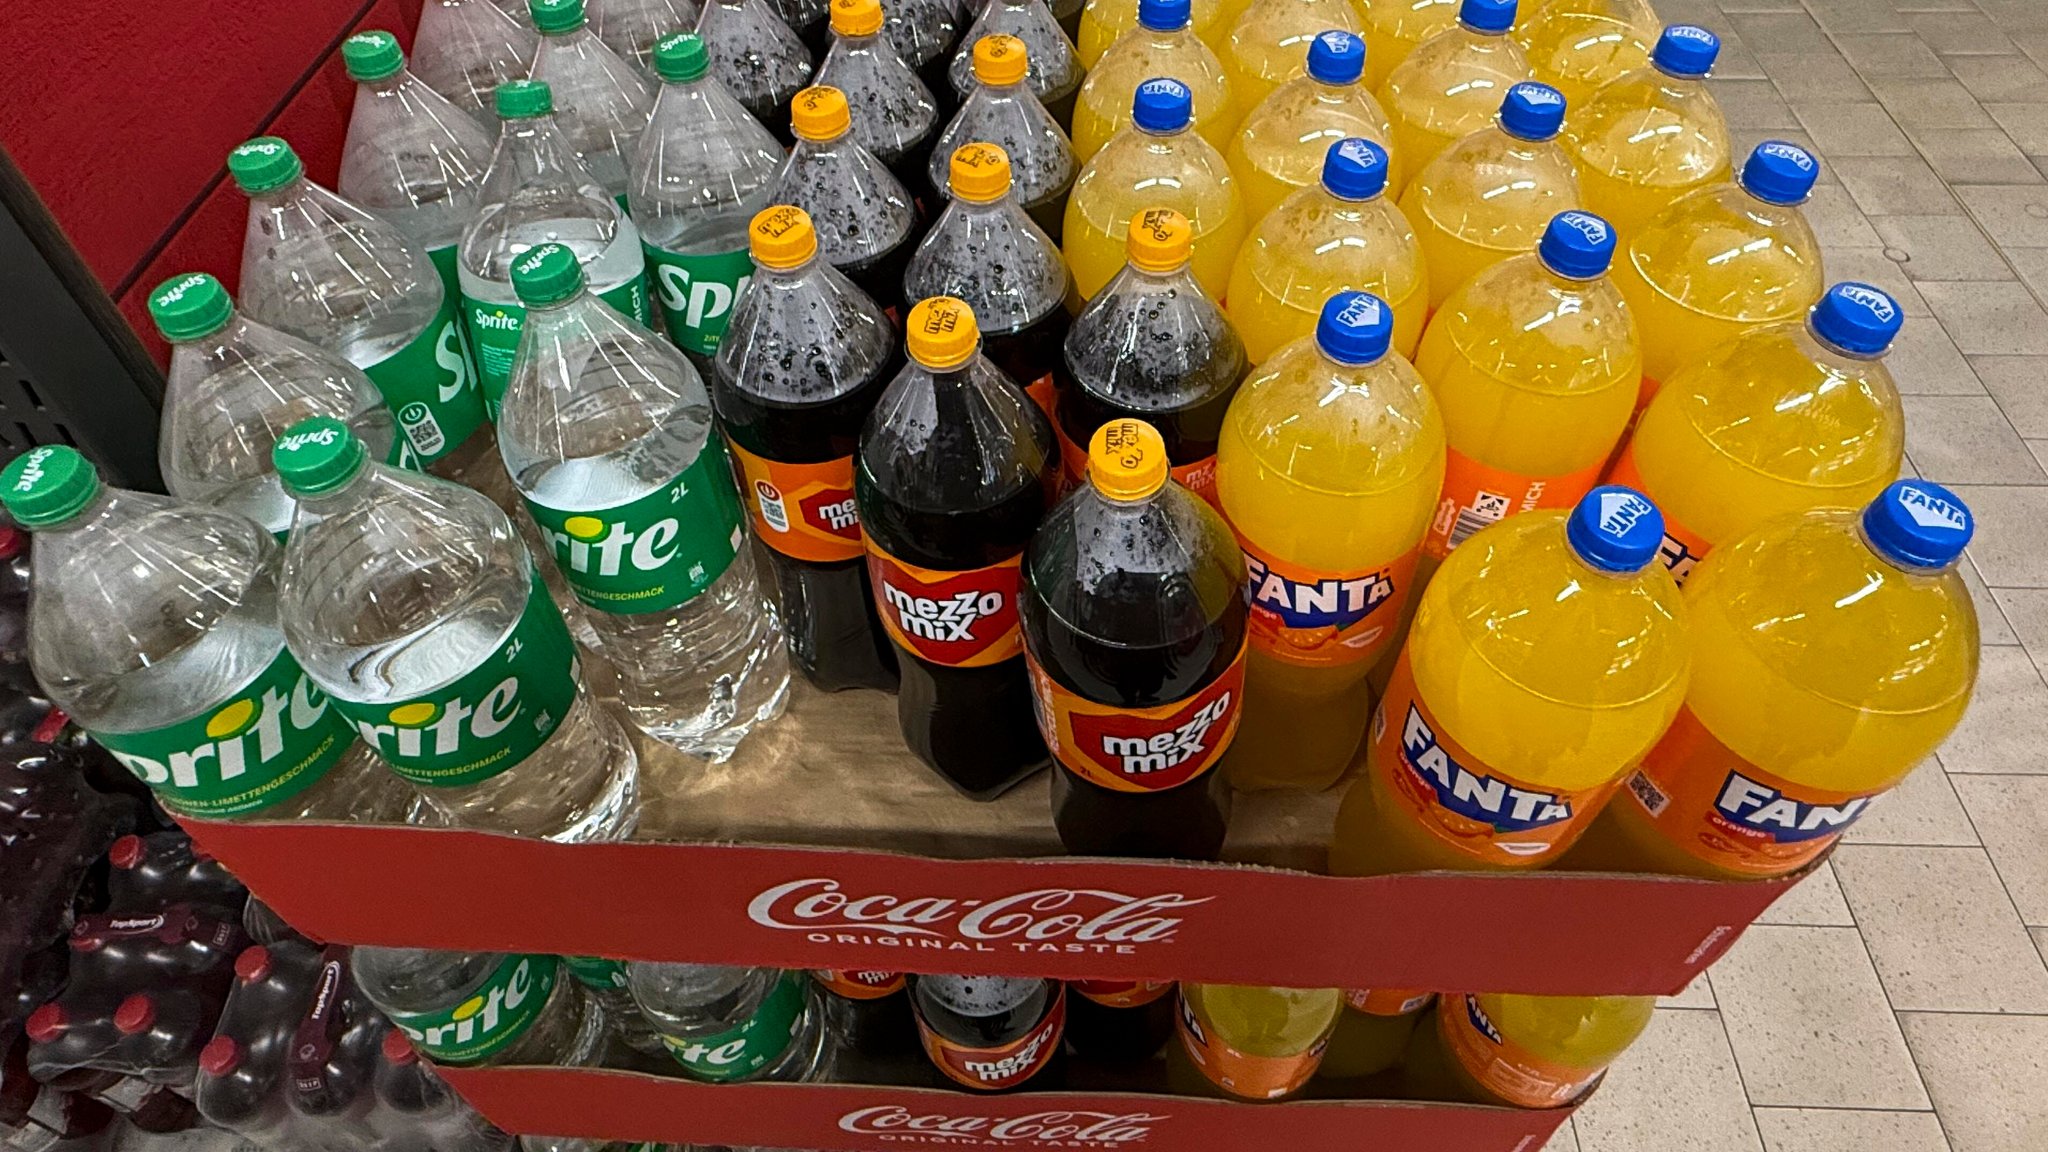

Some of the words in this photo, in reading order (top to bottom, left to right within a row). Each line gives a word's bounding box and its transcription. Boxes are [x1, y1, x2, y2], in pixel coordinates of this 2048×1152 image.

[1563, 213, 1607, 243] FANTA
[515, 243, 560, 275] Sprite
[156, 273, 207, 308] Sprite
[1843, 286, 1893, 321] FANTA
[475, 308, 519, 331] Sprite
[277, 427, 339, 452] Sprite
[21, 448, 53, 492] Sprite
[670, 482, 689, 504] 2L
[1902, 489, 1964, 528] FANTA
[1603, 494, 1652, 536] FANTA
[883, 580, 1003, 622] mezzo
[899, 609, 976, 642] mix
[505, 637, 524, 664] 2L
[1103, 690, 1231, 757] mezzo
[1121, 724, 1205, 774] mix
[1403, 706, 1568, 822] FANTA
[1712, 815, 1767, 839] orange
[747, 877, 1218, 944] Coca-Cola
[806, 932, 996, 953] ORIGINAL
[1011, 942, 1137, 955] TASTE
[964, 1022, 1053, 1072] mezzo
[979, 1050, 1038, 1081] mix
[838, 1105, 1173, 1142] Coca-Cola
[878, 1133, 1017, 1147] ORIGINAL
[1033, 1139, 1119, 1149] TASTE
